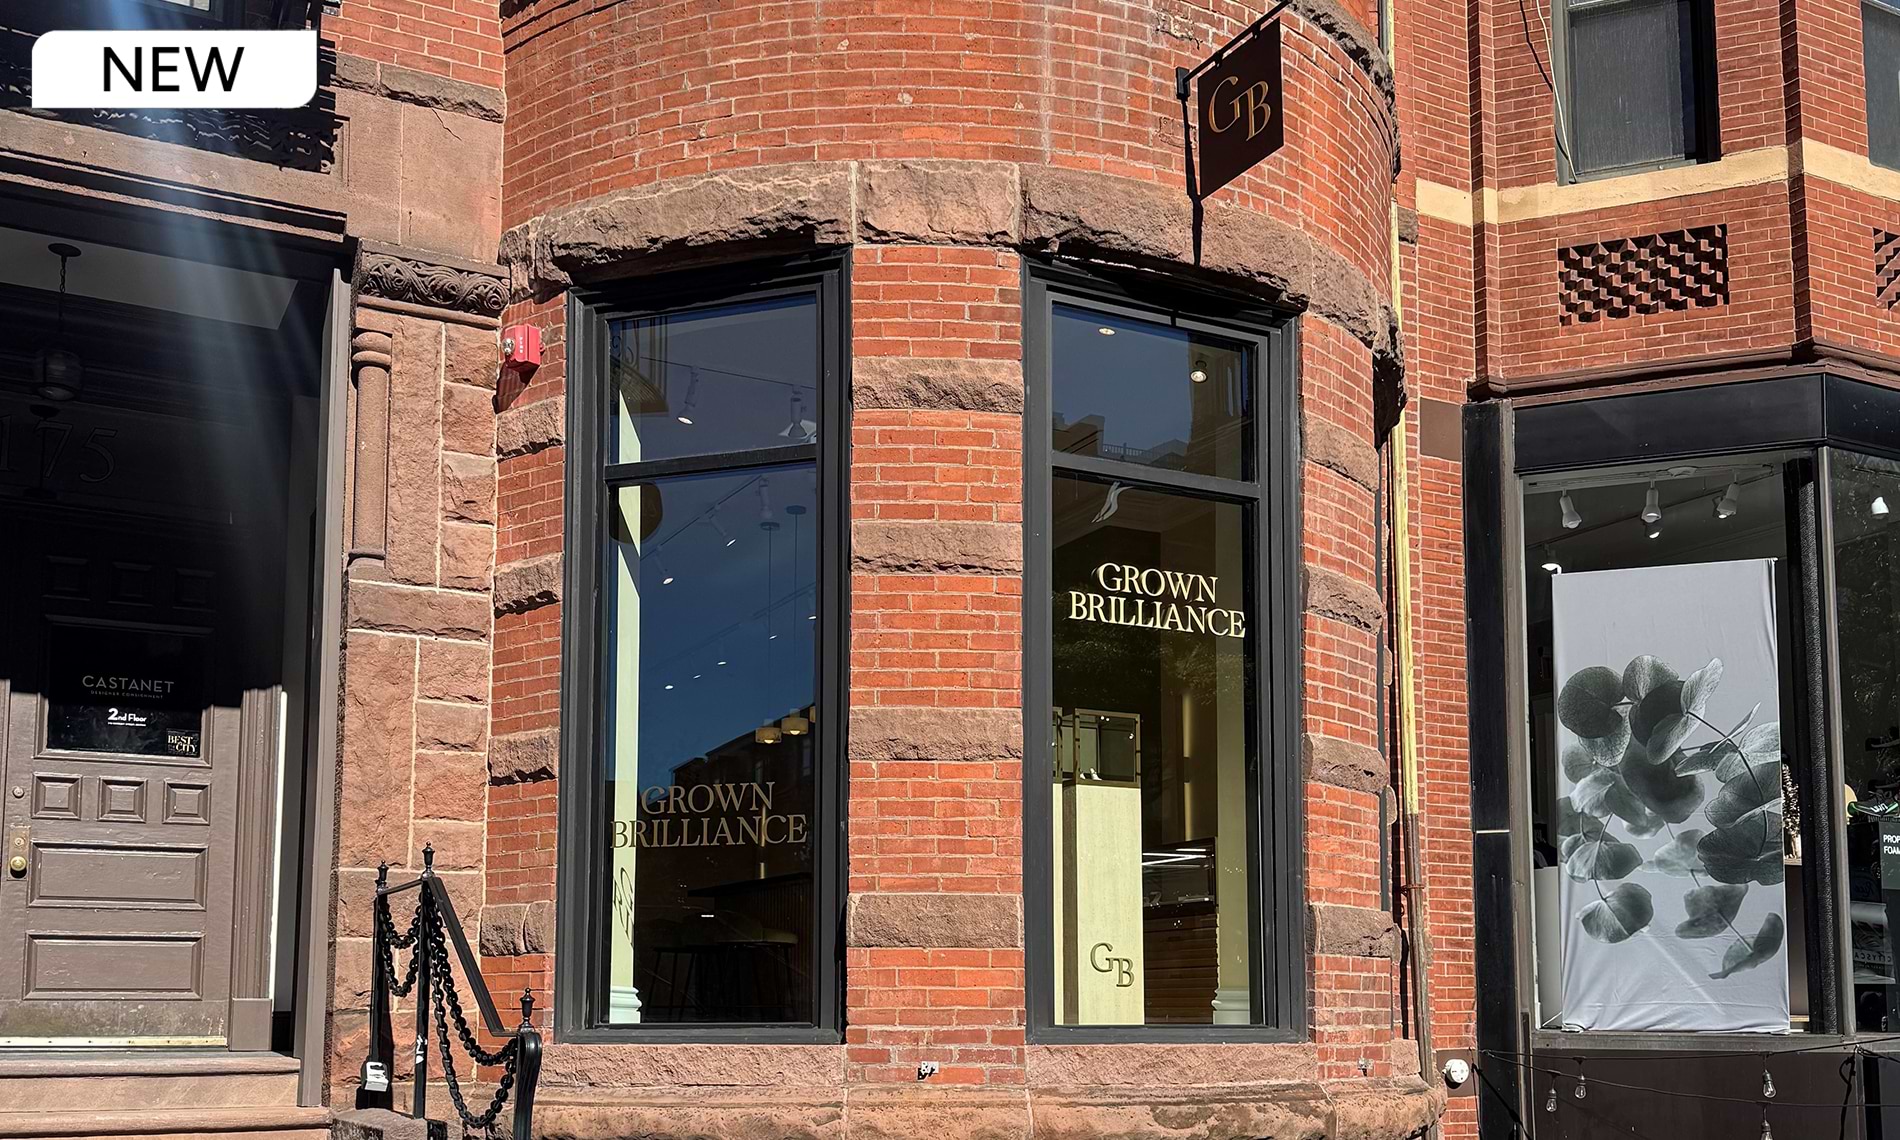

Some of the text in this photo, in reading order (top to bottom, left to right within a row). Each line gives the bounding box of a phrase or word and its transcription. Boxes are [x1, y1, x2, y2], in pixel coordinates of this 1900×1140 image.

[1208, 75, 1271, 142] GB
[0, 414, 118, 483] 175
[1098, 562, 1218, 604] GROWN
[1068, 590, 1246, 639] BRILLIANCE
[82, 675, 174, 693] CASTANET
[107, 707, 147, 722] 2nd Floor
[168, 735, 193, 745] BEST
[641, 781, 775, 815] GROWN
[610, 813, 808, 849] BRILLIANCE
[1090, 942, 1134, 988] GB
